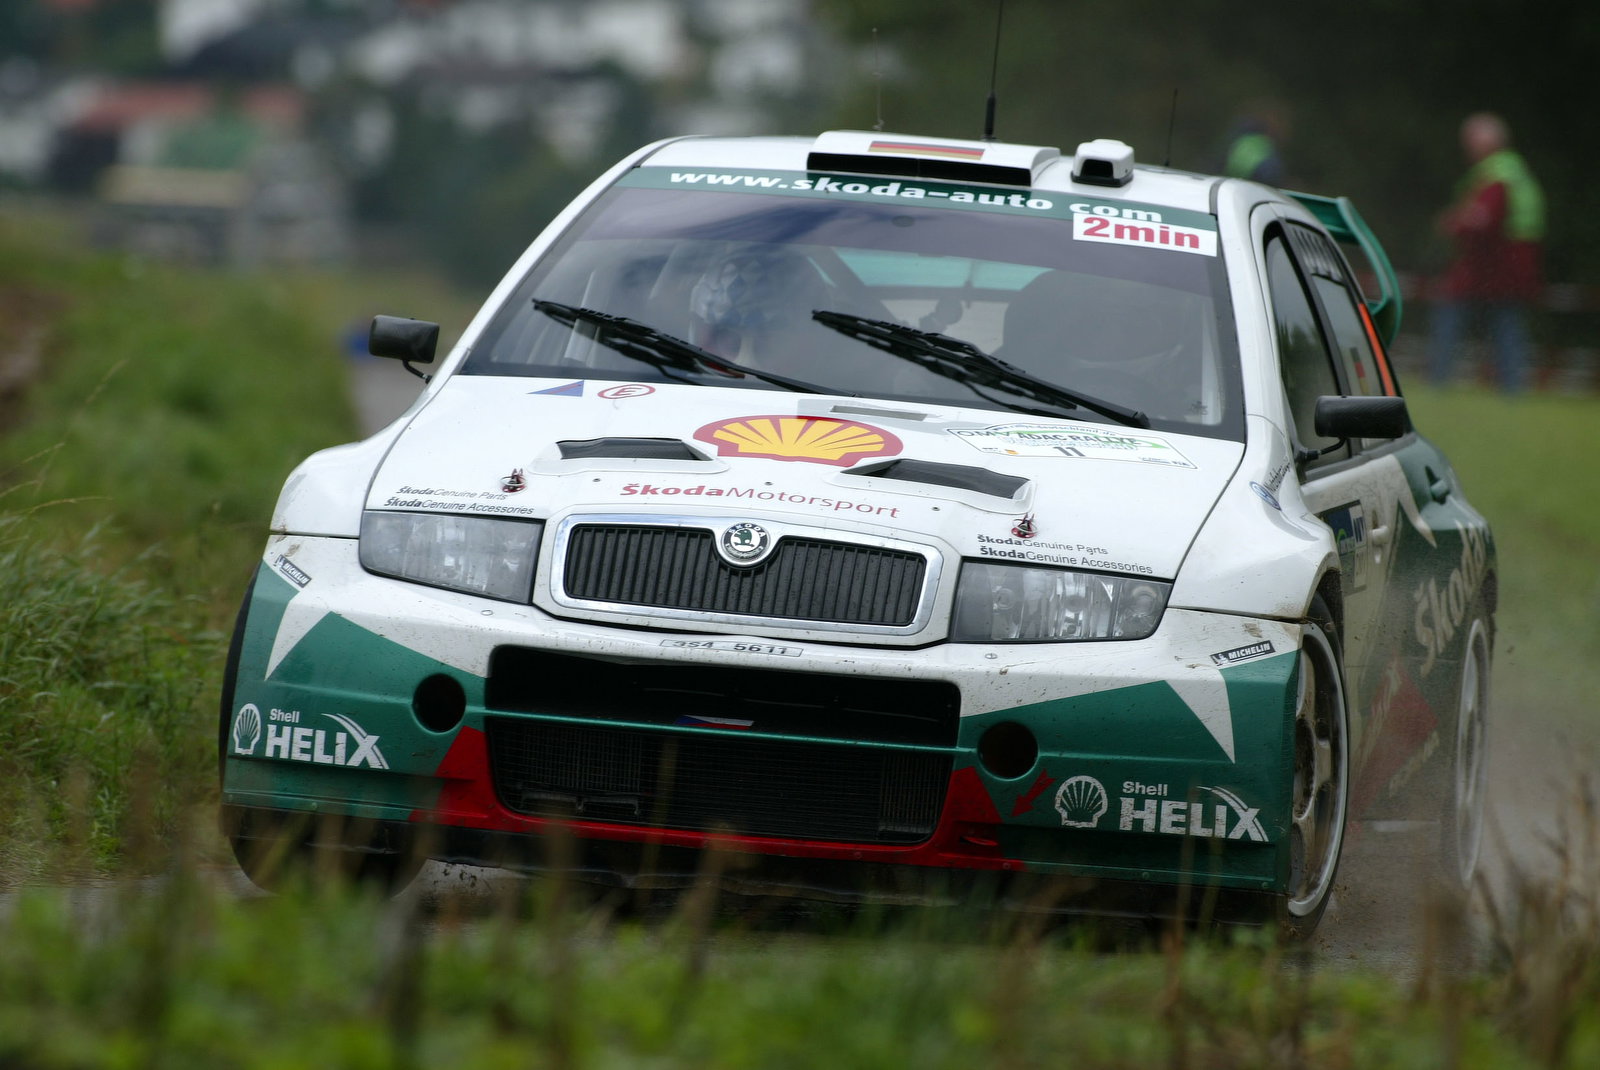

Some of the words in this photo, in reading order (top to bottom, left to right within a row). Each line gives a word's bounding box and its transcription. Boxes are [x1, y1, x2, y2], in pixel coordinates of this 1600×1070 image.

[1083, 217, 1200, 249] 2min
[1016, 432, 1067, 441] ADAC
[1068, 435, 1142, 446] RALLYE
[1053, 446, 1086, 457] 11
[479, 491, 509, 501] Parts
[467, 502, 535, 515] Accessories
[1076, 544, 1109, 556] Parts
[1081, 556, 1153, 574] Accessories
[283, 562, 310, 584] MICHELIN
[734, 643, 788, 655] 5611
[1228, 642, 1271, 660] MICHELIN
[269, 708, 300, 723] Shell
[265, 713, 390, 770] HELIX
[1122, 781, 1168, 797] Shell
[1119, 785, 1269, 842] HELIX
